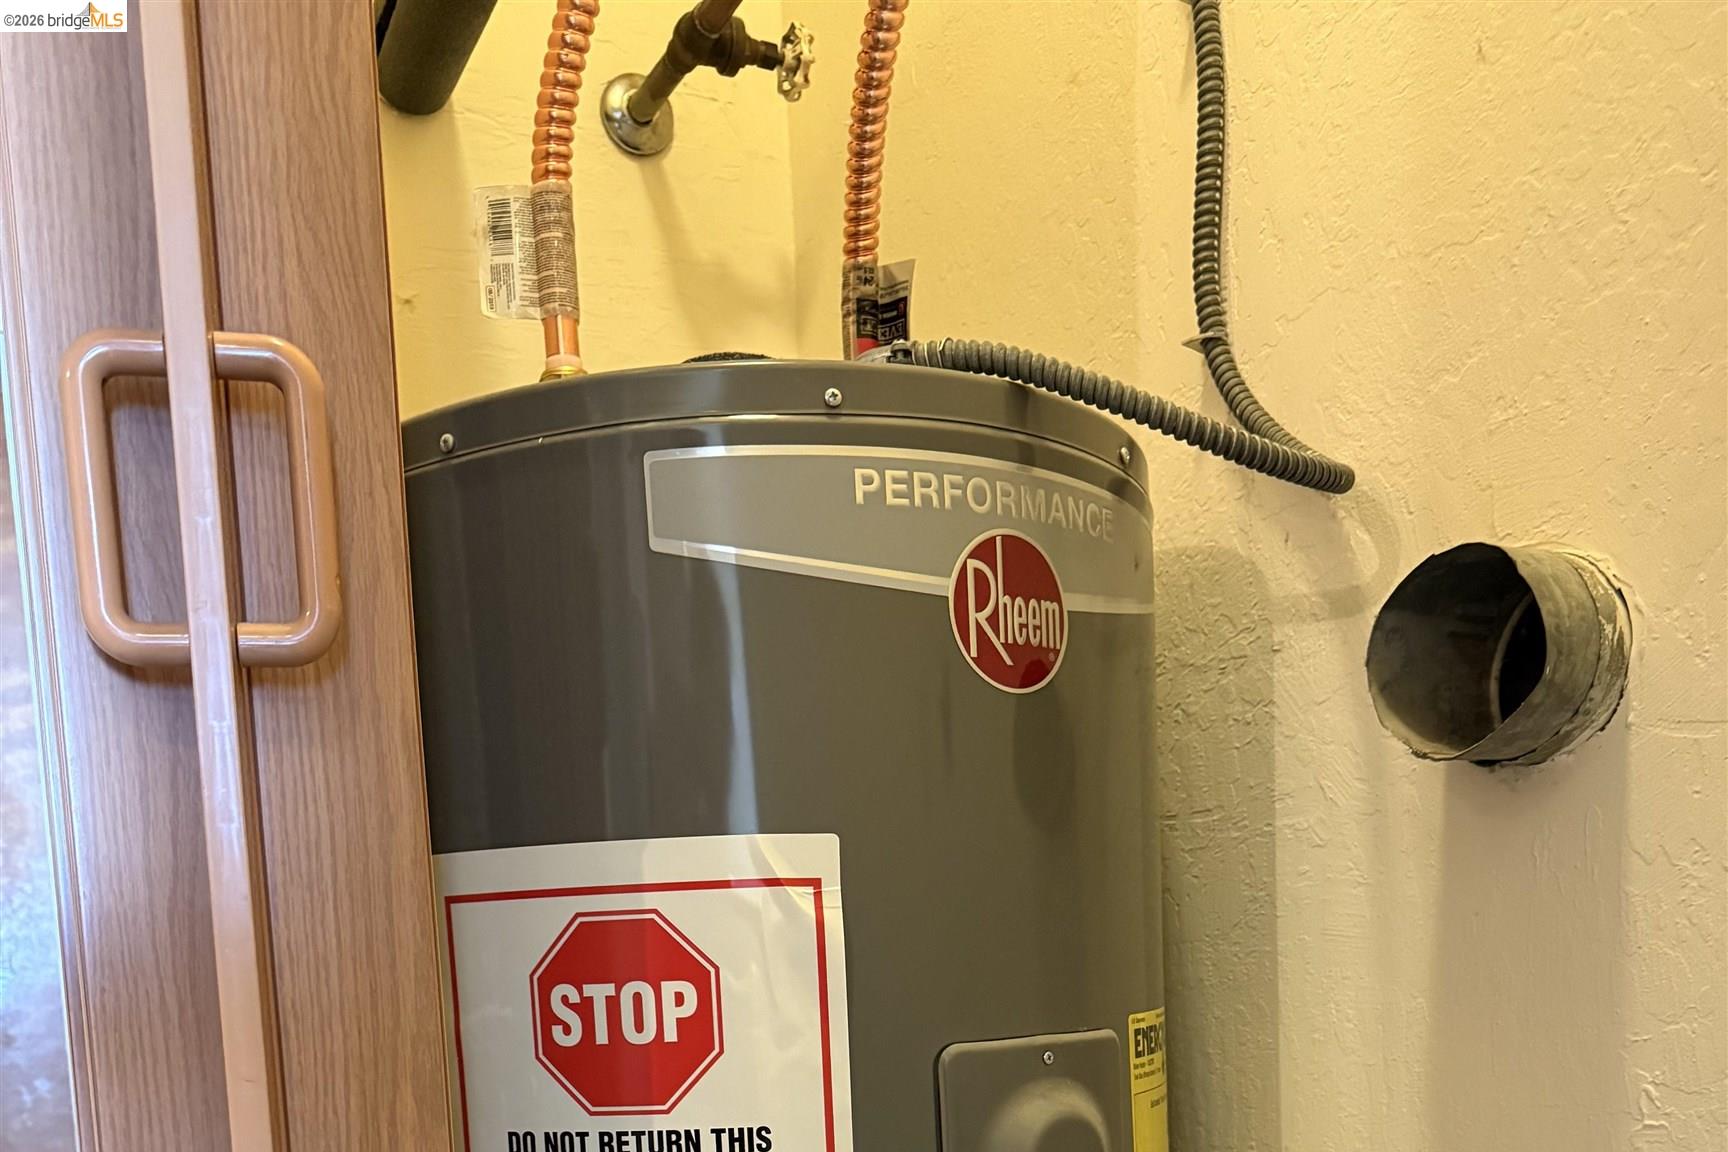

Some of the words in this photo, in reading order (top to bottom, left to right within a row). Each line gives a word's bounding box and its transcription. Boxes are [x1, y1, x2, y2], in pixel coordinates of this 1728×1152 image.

[853, 467, 1115, 544] PERFORMANCE
[965, 535, 1061, 667] Rheem
[549, 980, 698, 1047] STOP
